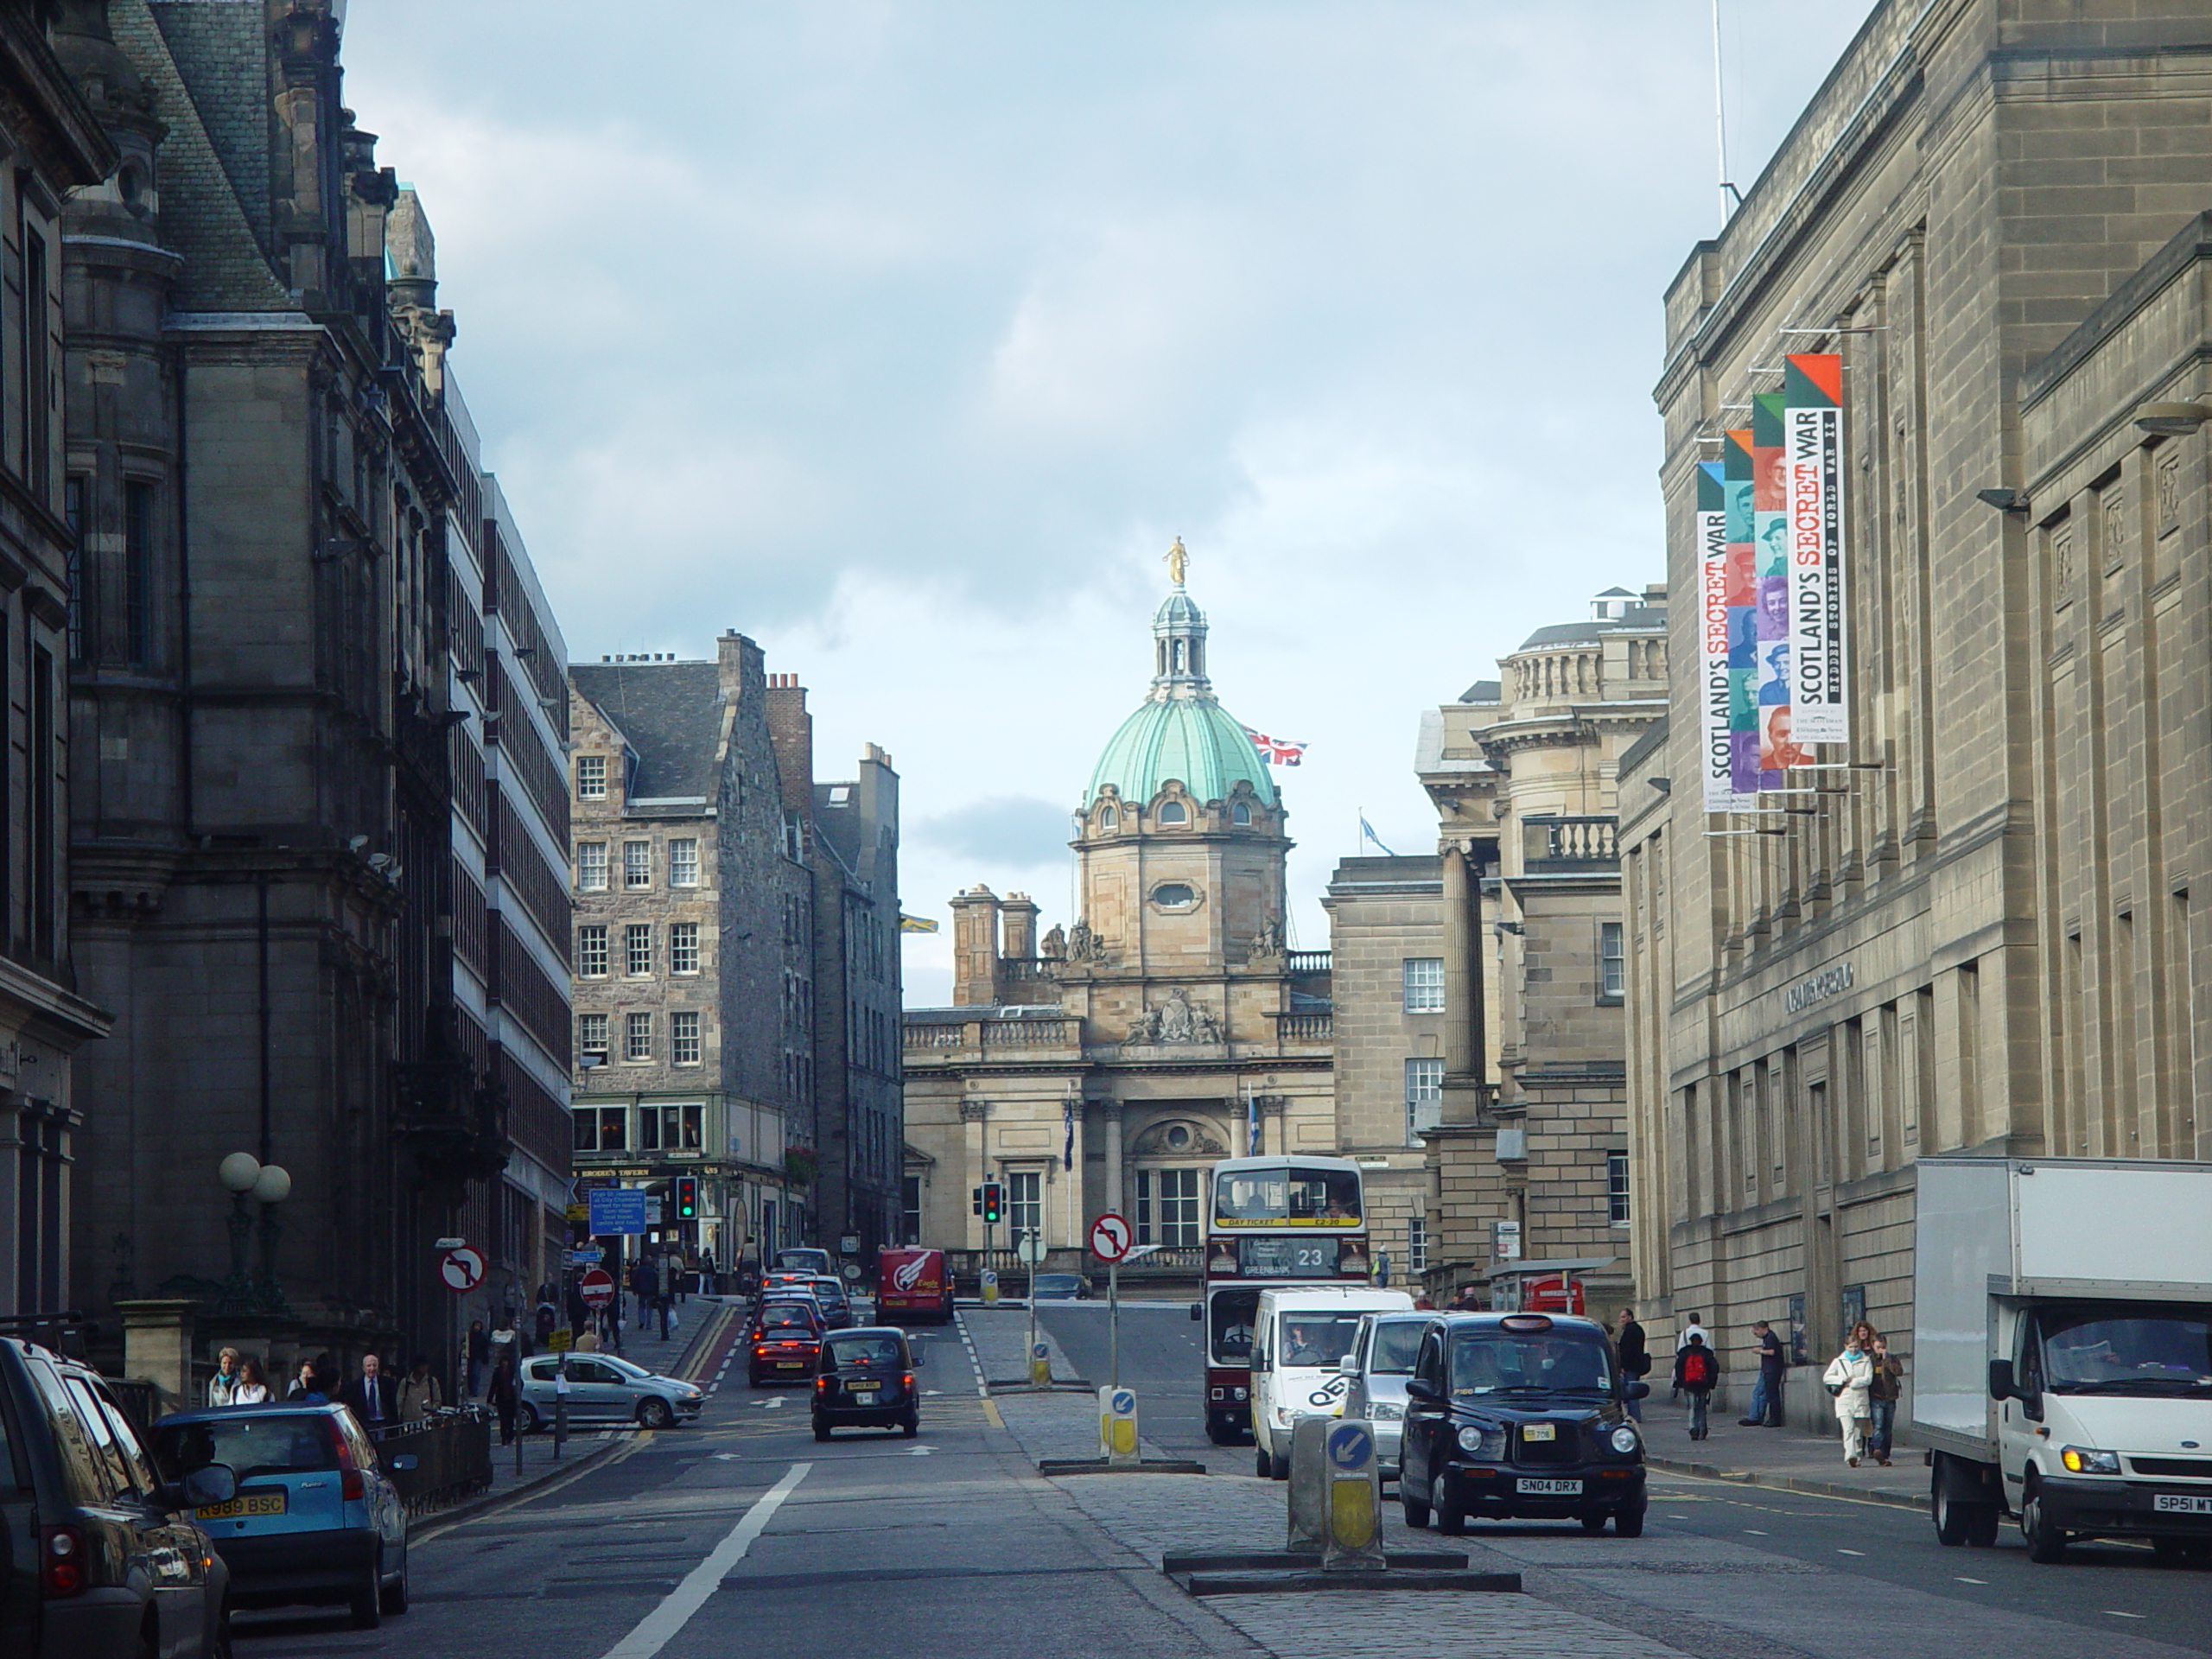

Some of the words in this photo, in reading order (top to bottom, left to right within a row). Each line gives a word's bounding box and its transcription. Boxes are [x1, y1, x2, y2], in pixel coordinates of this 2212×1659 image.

[1796, 411, 1818, 461] WAR
[1825, 422, 1835, 438] II
[1825, 448, 1836, 475] WAR
[1795, 465, 1821, 566] SECRET
[1826, 484, 1837, 530] WORLD
[1707, 514, 1726, 559] WAR
[1827, 539, 1838, 556] OF
[1706, 562, 1728, 654] SECRET
[1827, 567, 1839, 629] STORIES
[1799, 572, 1822, 705] SCOTLAND'S
[1827, 640, 1840, 693] HIDDEN
[1710, 660, 1732, 779] SCOTLAND'S
[1244, 1266, 1289, 1274] GREENBANK
[1298, 1249, 1322, 1266] 23
[917, 1279, 938, 1288] Eagle
[1522, 1480, 1552, 1491] SN04
[1555, 1481, 1577, 1491] DRX
[200, 1499, 244, 1517] R989
[248, 1497, 281, 1512] BSC
[2159, 1497, 2193, 1511] SP51
